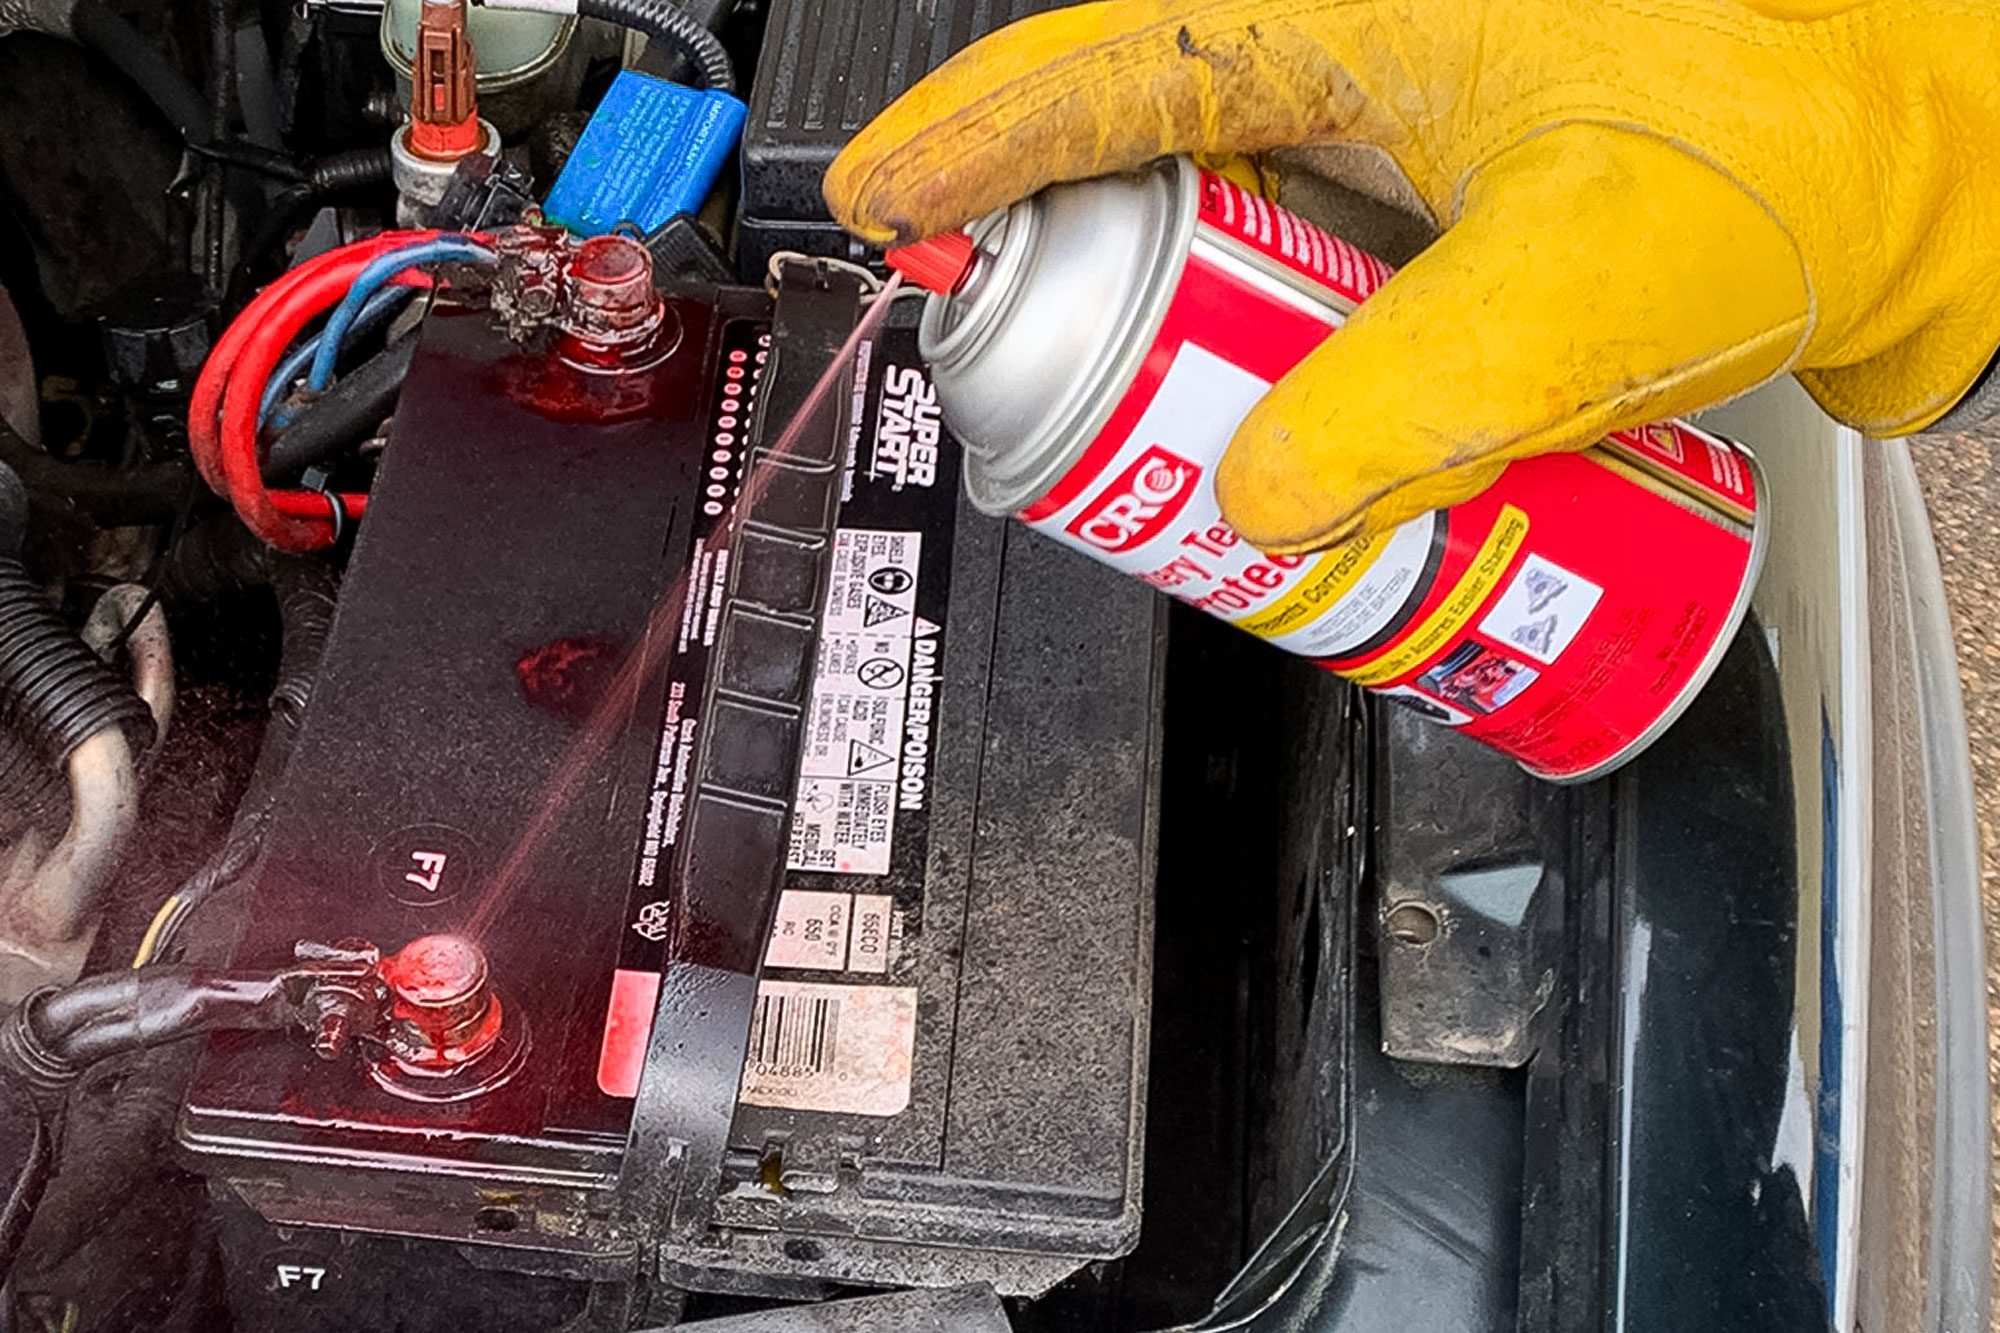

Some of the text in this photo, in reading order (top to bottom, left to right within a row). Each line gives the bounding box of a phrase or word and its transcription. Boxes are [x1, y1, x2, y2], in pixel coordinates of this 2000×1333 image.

[875, 364, 921, 484] START
[1079, 456, 1187, 548] CRC
[1180, 513, 1240, 558] Te
[1303, 536, 1375, 604] Corrosio
[868, 817, 888, 844] EYES
[404, 851, 446, 892] F7
[277, 1265, 326, 1290] F7
